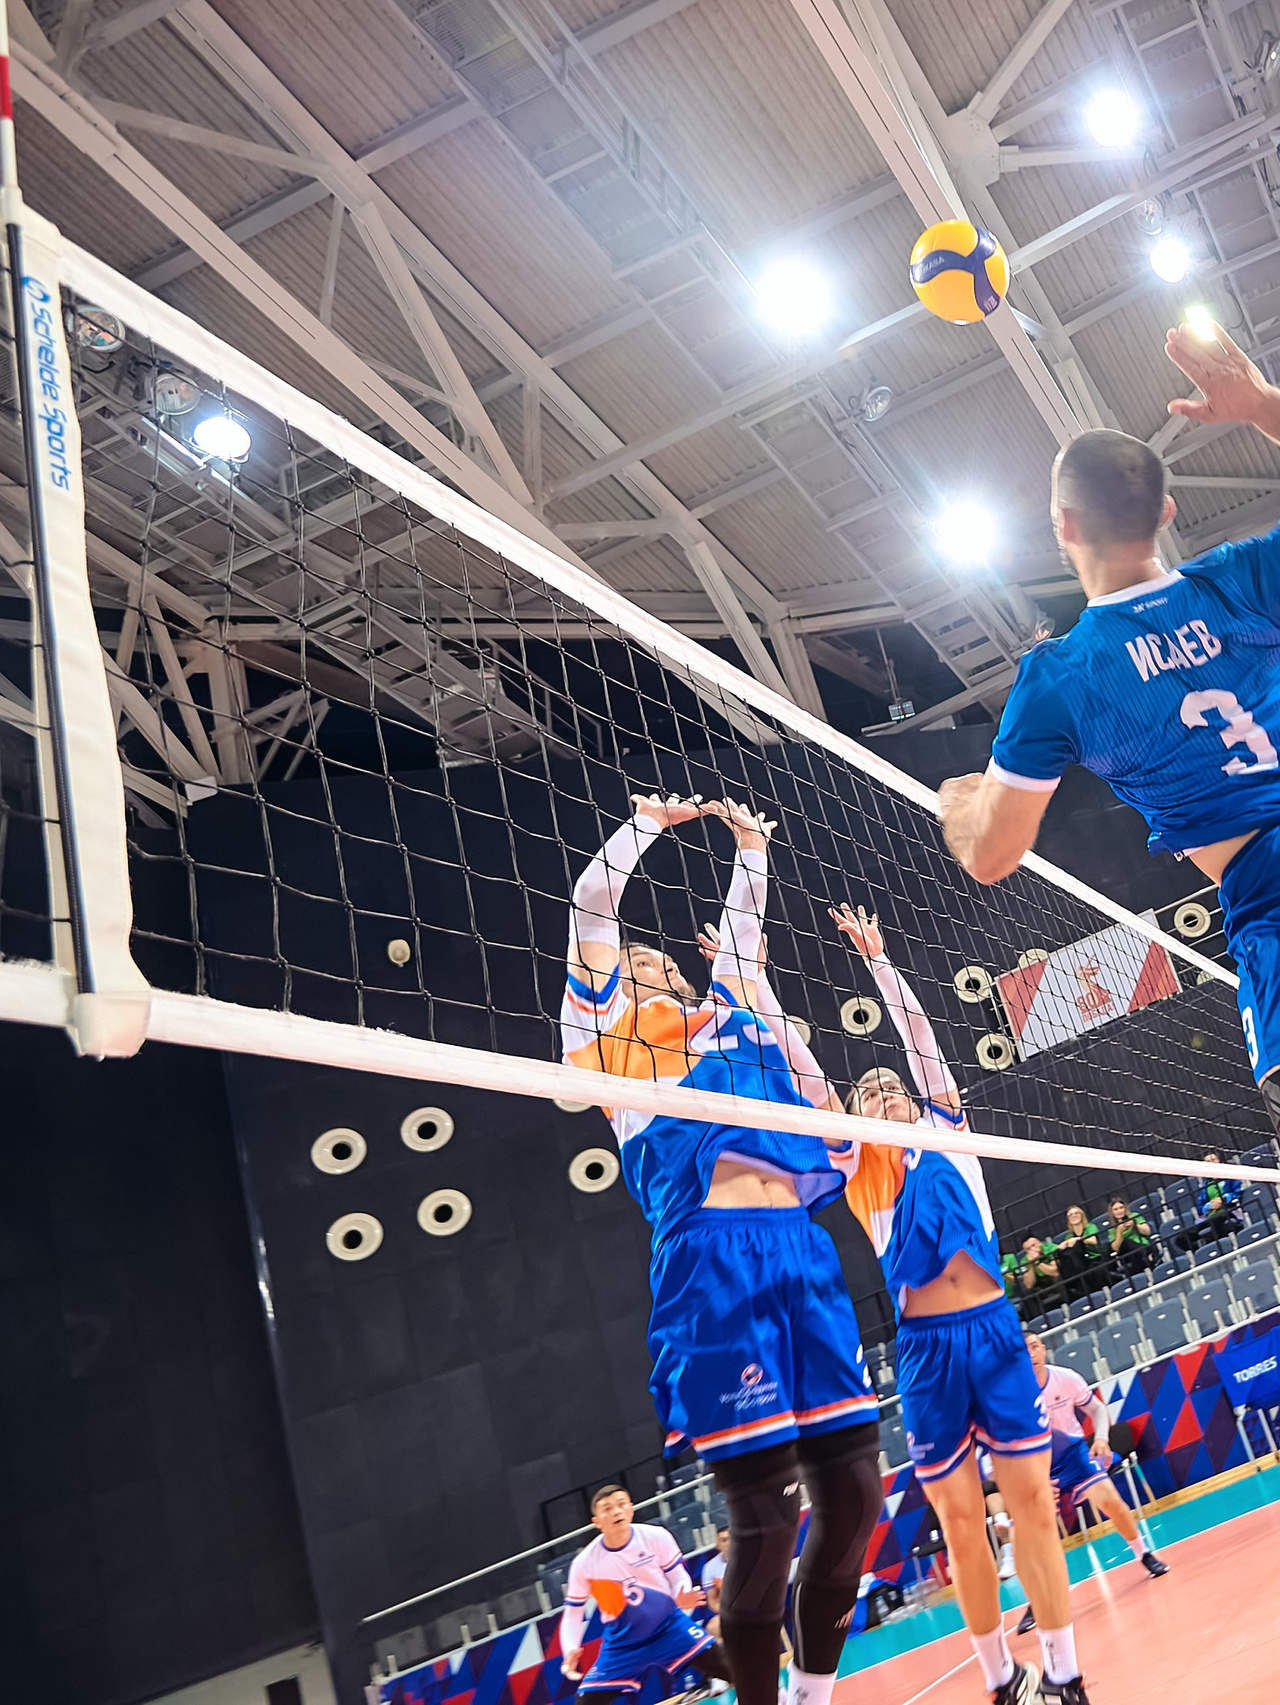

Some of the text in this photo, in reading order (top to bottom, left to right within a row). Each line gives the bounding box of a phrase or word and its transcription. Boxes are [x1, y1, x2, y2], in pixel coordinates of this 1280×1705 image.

[38, 401, 72, 491] sports
[1124, 619, 1222, 682] ИСАЕВ
[1180, 688, 1279, 777] 3
[1233, 1355, 1278, 1383] TORRES
[622, 1576, 645, 1606] 5
[688, 1626, 705, 1639] 5
